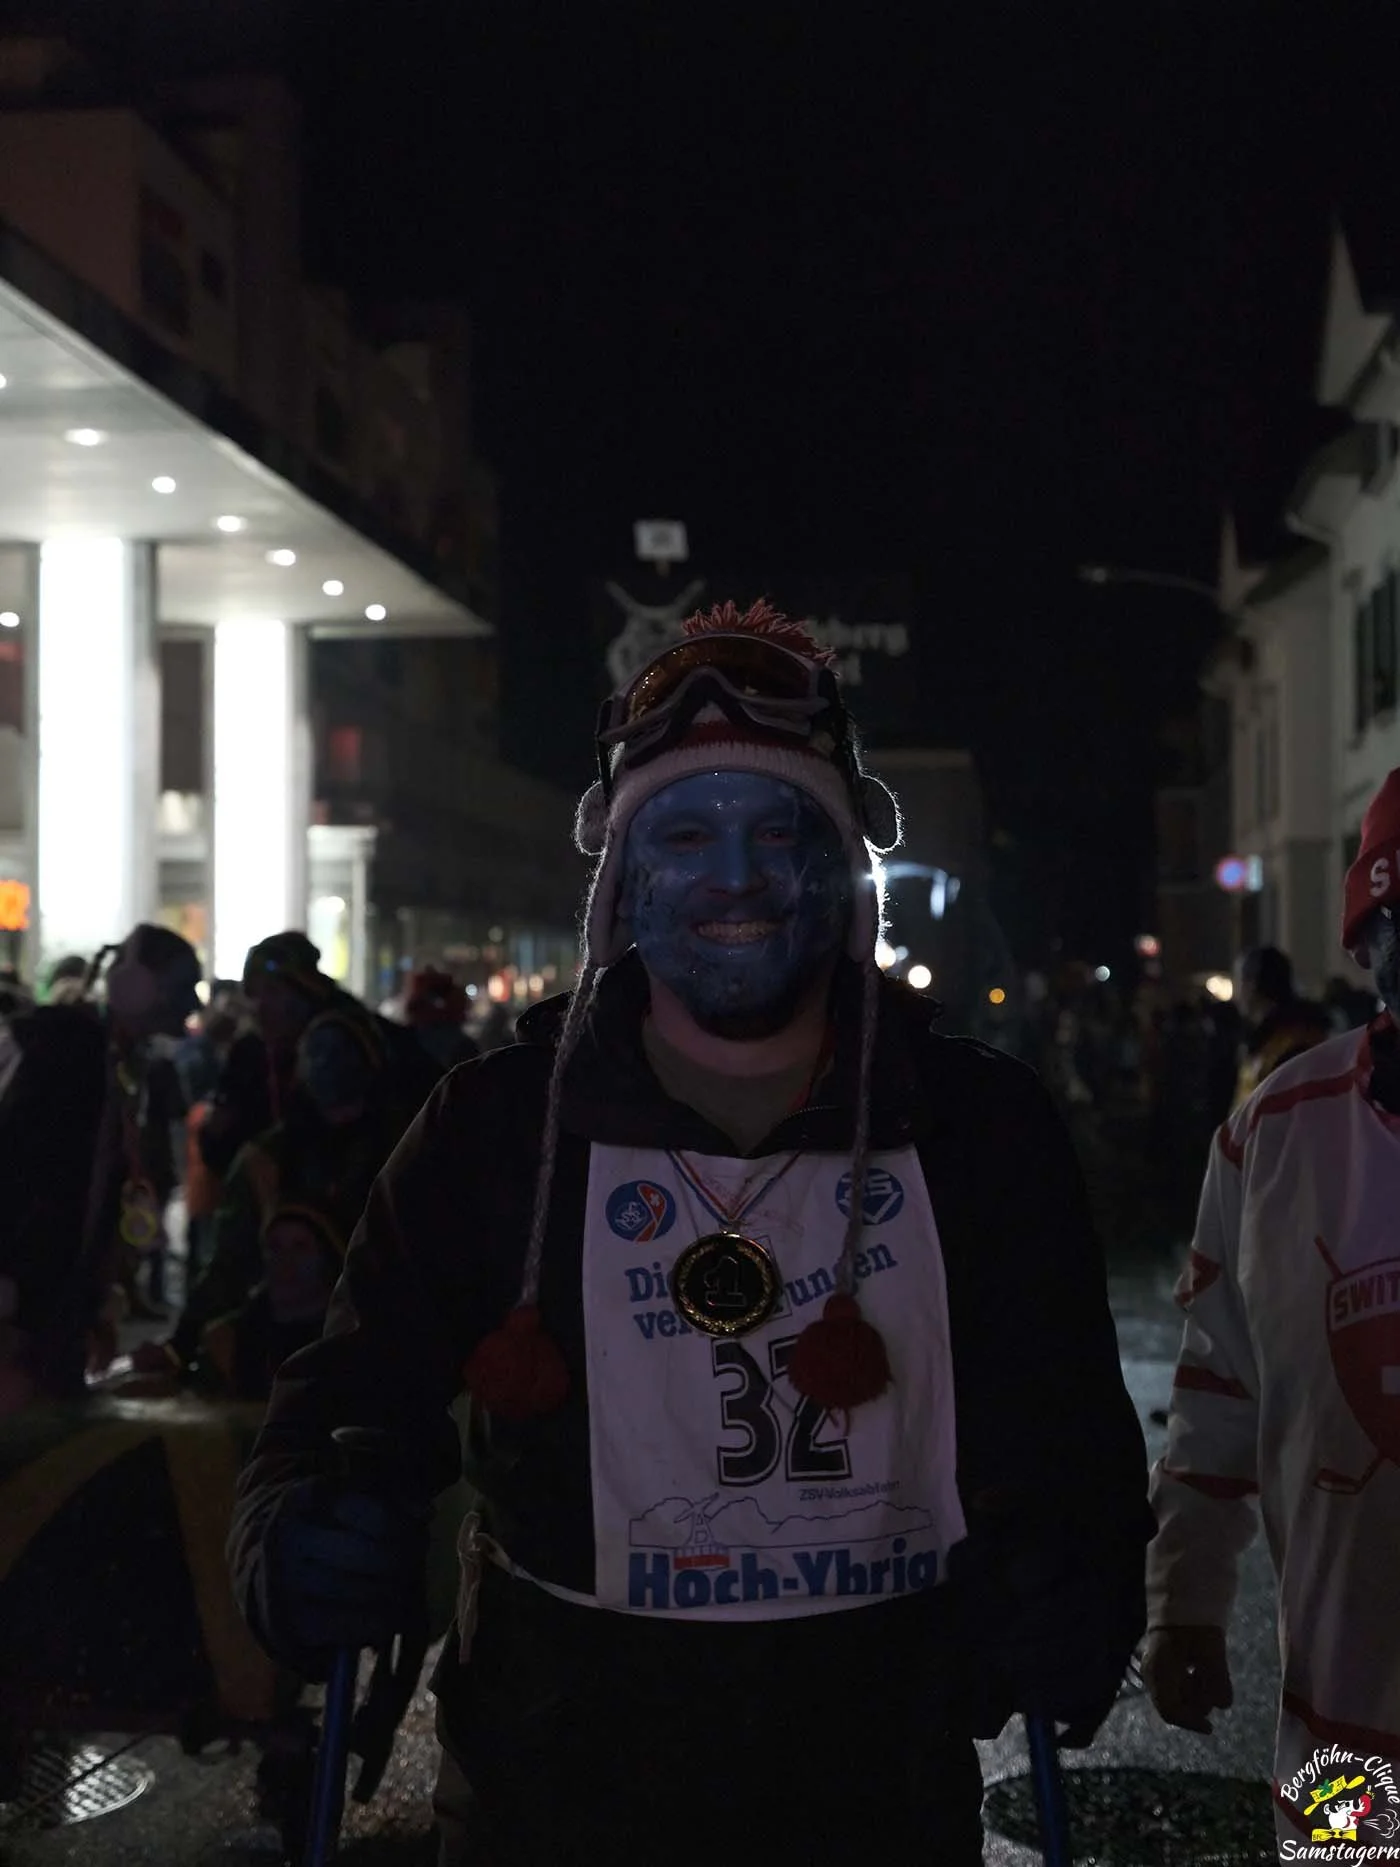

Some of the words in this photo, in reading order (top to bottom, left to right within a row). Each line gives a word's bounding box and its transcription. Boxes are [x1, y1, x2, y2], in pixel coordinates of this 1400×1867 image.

[1369, 852, 1400, 898] S
[625, 1261, 670, 1302] Di
[711, 1337, 853, 1487] 32
